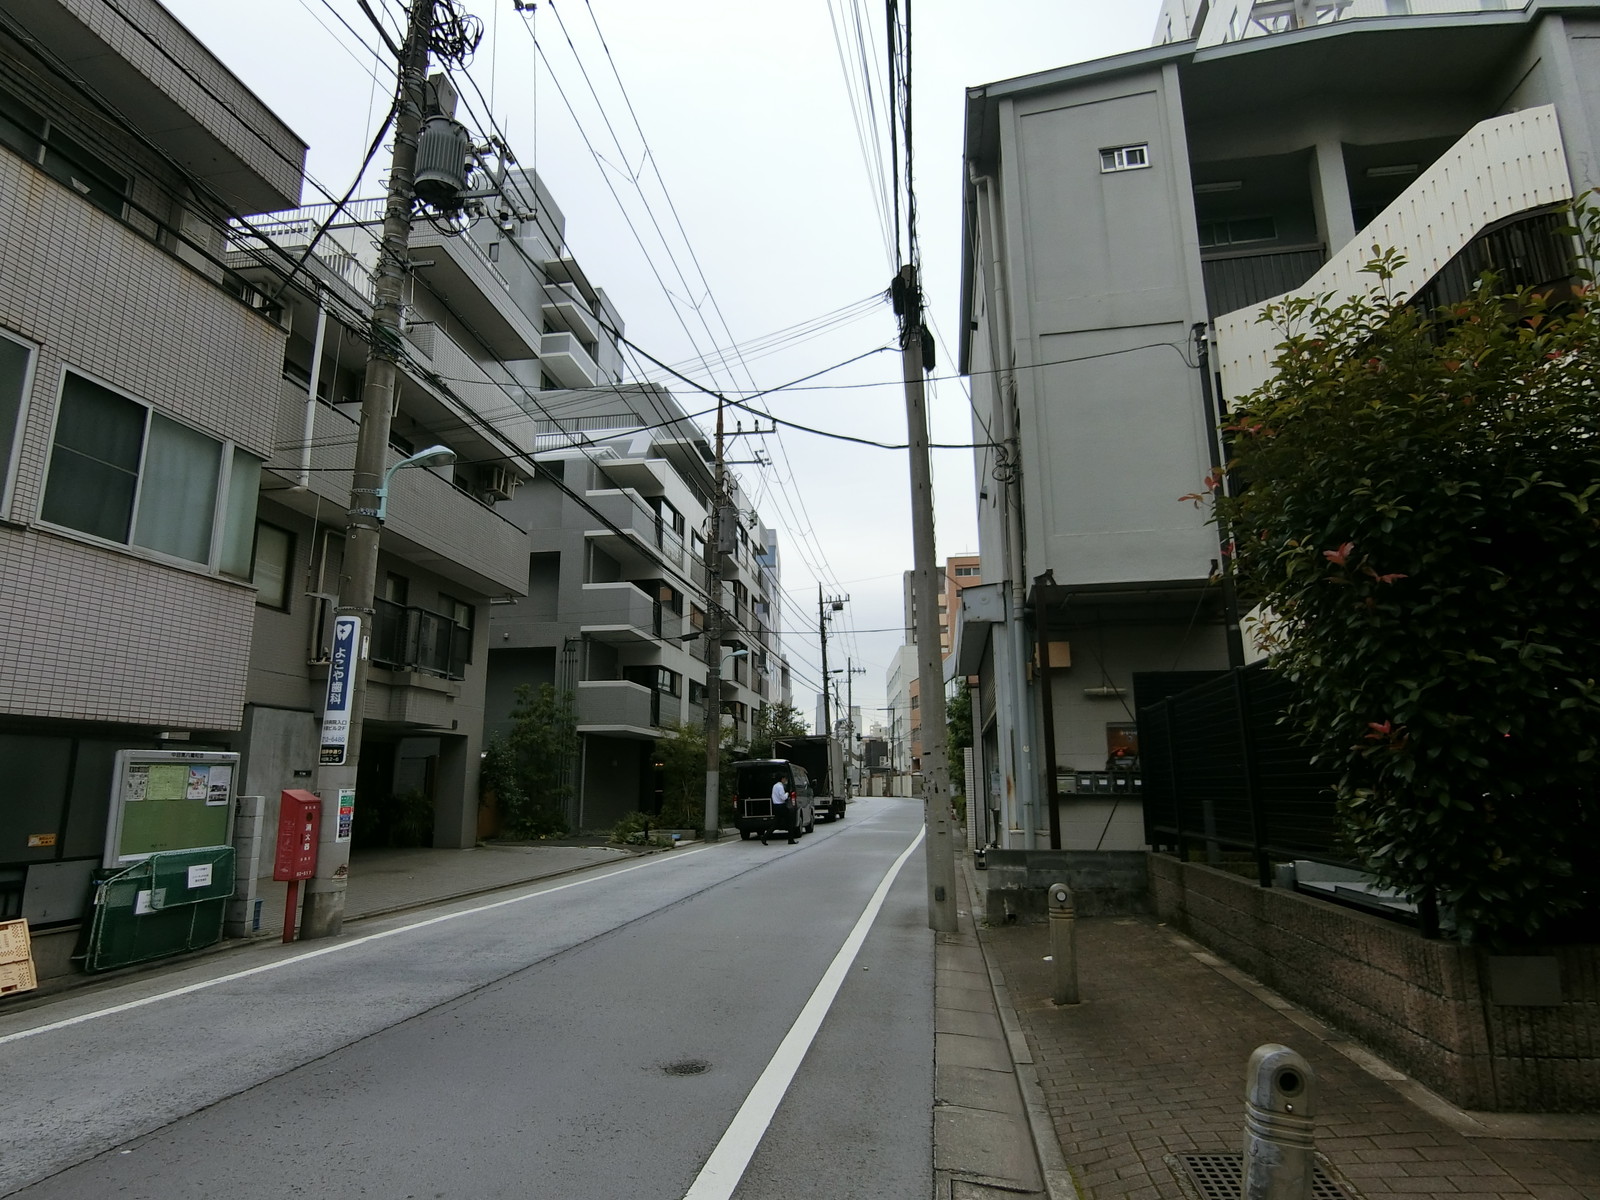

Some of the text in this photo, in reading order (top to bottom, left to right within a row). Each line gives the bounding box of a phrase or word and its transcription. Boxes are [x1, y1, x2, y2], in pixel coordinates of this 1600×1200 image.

[330, 647, 347, 705] よこや歯科
